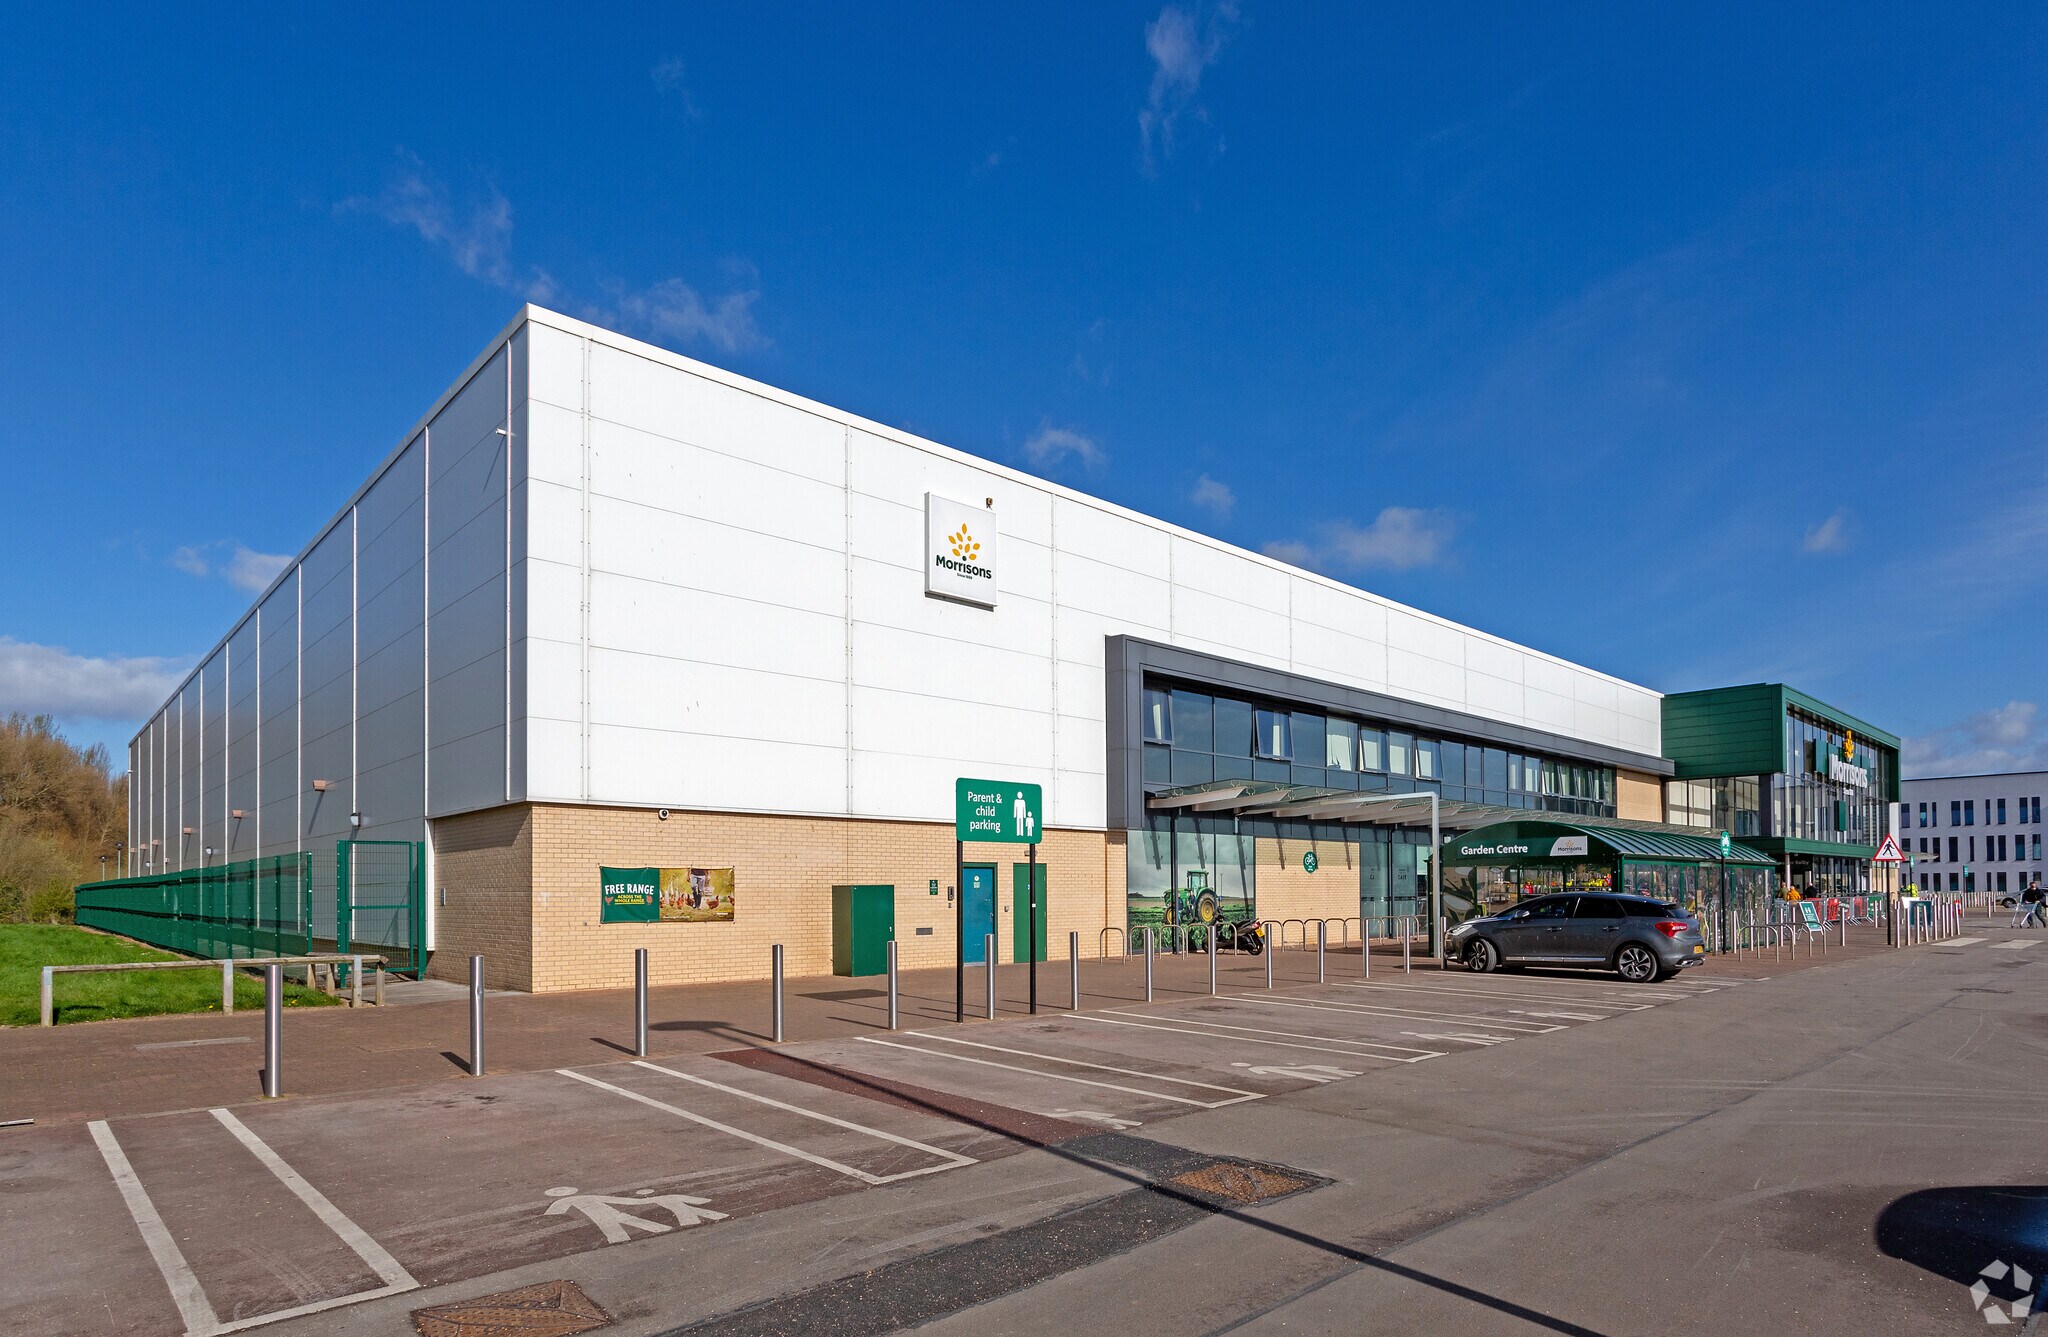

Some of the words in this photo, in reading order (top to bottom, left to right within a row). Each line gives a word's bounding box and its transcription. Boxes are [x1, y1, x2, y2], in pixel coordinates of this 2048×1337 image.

[936, 555, 992, 579] Morrisons
[1829, 754, 1868, 788] Morrisons
[968, 791, 994, 803] Parent
[996, 794, 1002, 803] &
[976, 806, 995, 817] child
[970, 820, 1001, 833] parking
[1461, 845, 1494, 855] Garden
[1496, 845, 1528, 853] Centre
[605, 884, 624, 894] FREE
[627, 884, 654, 895] RANGE
